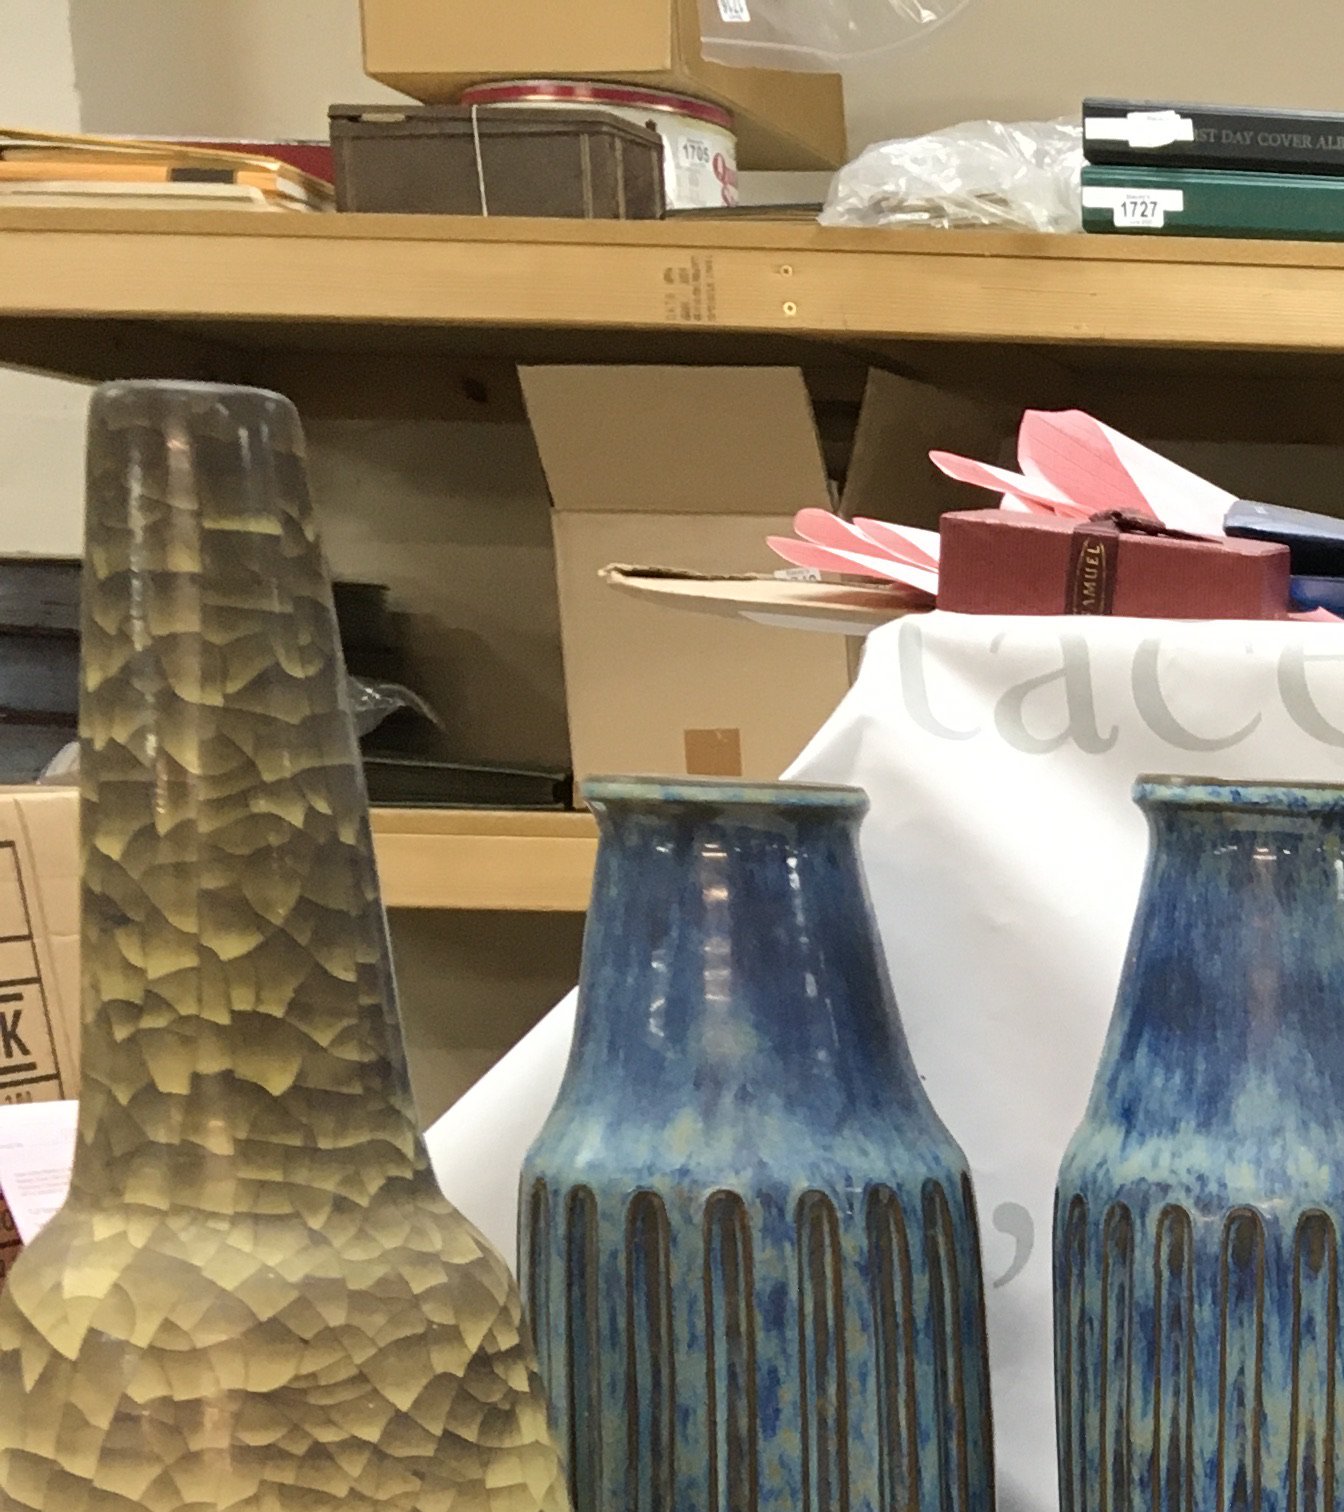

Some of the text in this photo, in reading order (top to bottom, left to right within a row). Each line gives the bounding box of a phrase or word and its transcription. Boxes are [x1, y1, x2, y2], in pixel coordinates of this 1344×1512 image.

[1221, 129, 1253, 145] DAY
[1257, 132, 1313, 149] COVER
[683, 143, 710, 164] 1705
[1121, 200, 1157, 218] 1727
[1082, 545, 1100, 614] AMUEL
